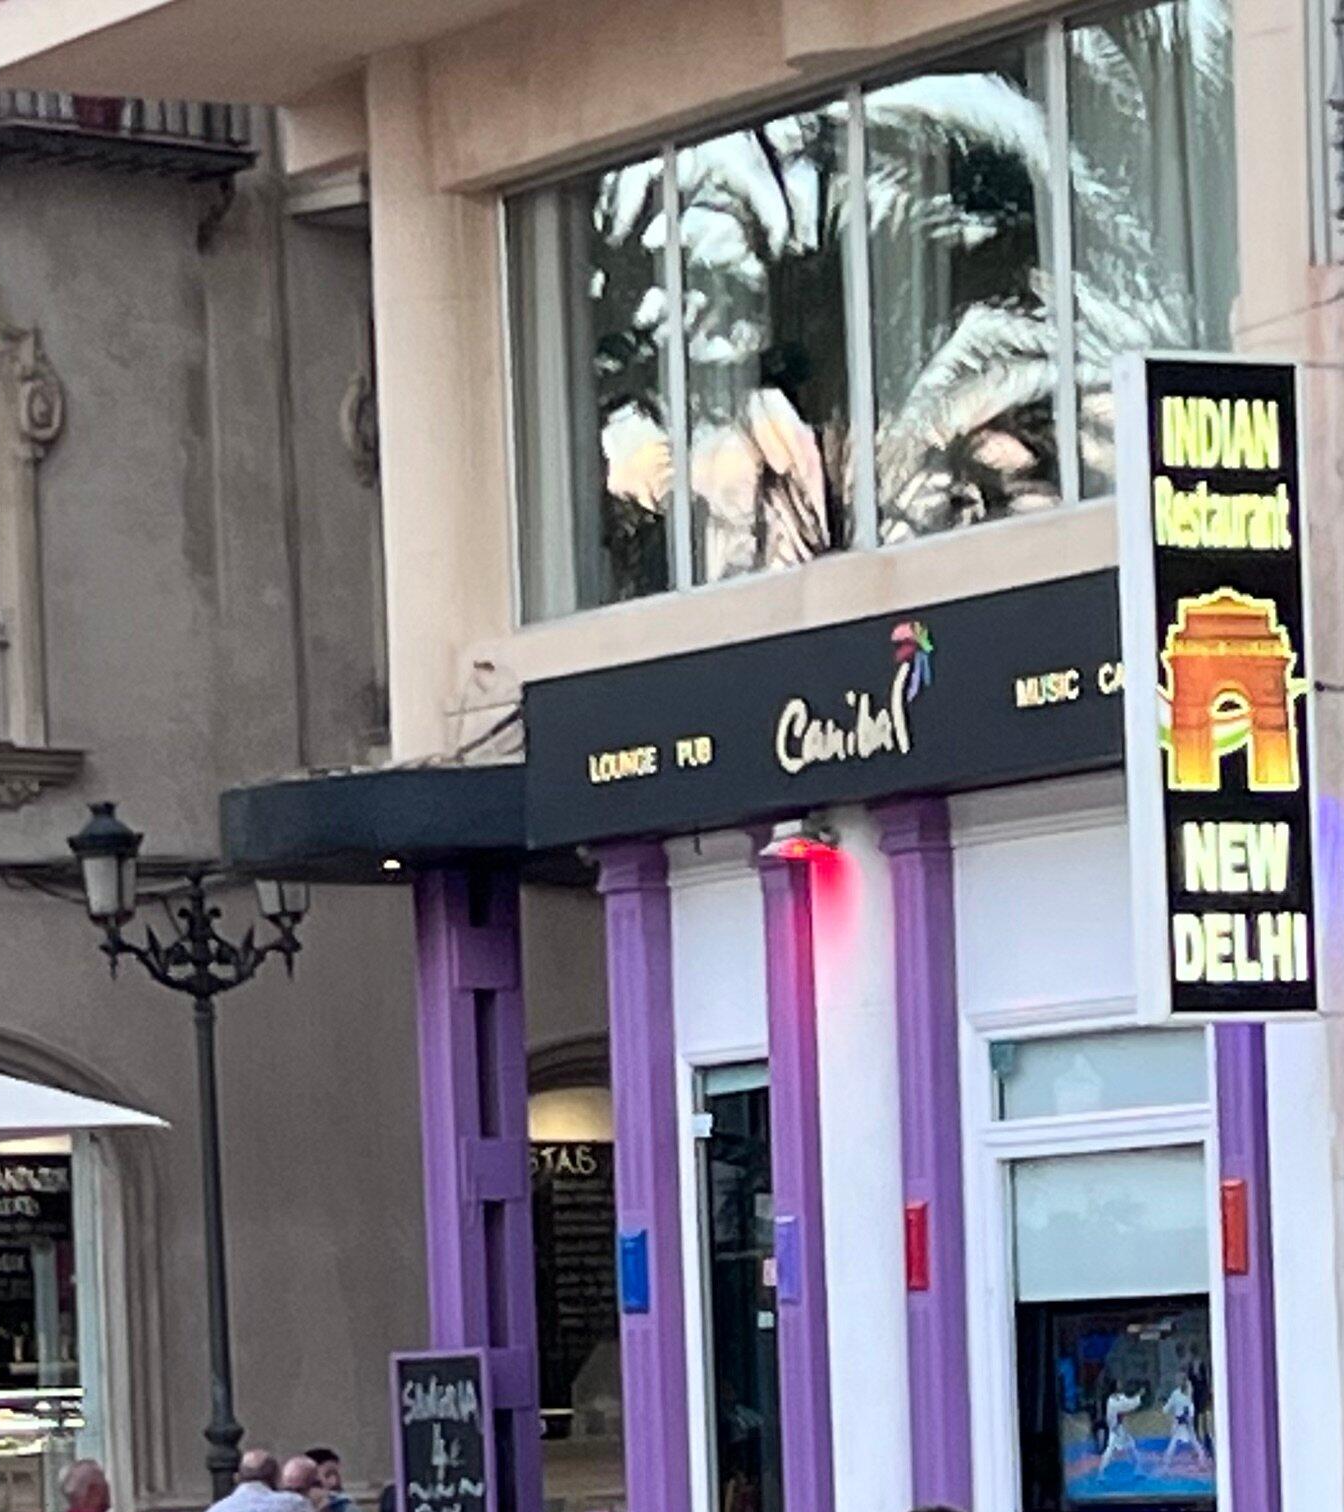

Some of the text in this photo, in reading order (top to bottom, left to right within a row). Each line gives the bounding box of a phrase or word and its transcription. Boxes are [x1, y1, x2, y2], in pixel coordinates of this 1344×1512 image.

[1162, 396, 1280, 468] INDIAN
[1154, 475, 1291, 550] Restaurant
[1016, 668, 1080, 708] MUSIC
[588, 736, 713, 783] LOUNGE PUB
[1183, 821, 1289, 892] NEW
[1172, 912, 1309, 984] DELHI
